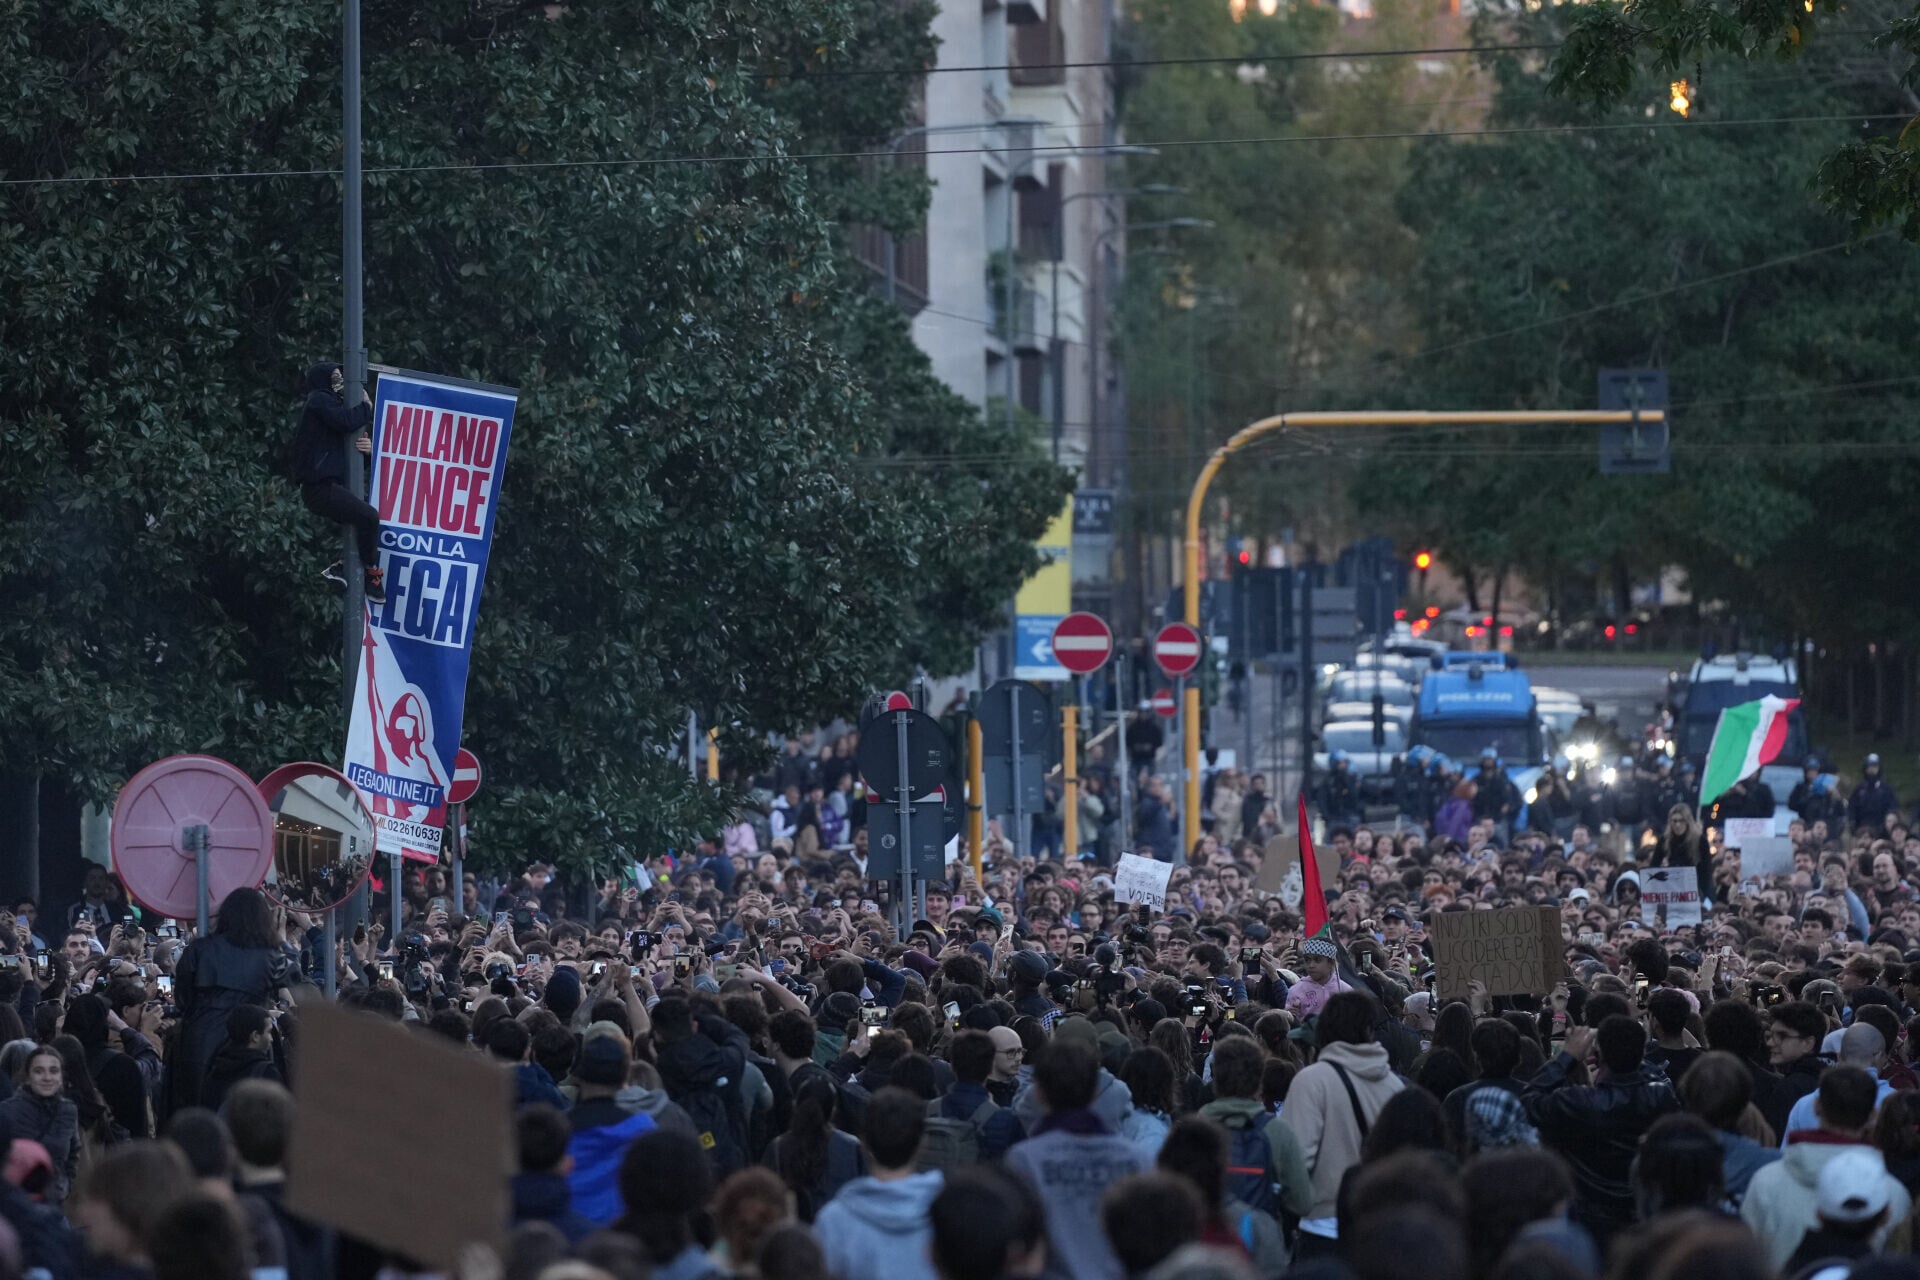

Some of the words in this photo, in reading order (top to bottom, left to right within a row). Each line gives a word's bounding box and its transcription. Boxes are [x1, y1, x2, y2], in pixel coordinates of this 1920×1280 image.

[381, 404, 499, 469] MILANO
[378, 456, 490, 535] VINCE
[380, 530, 433, 553] CON
[437, 538, 466, 559] LA
[351, 766, 439, 804] LEGAONLINE.IT
[1438, 936, 1512, 966] UCCIDERE
[1440, 963, 1505, 994] BASTA
